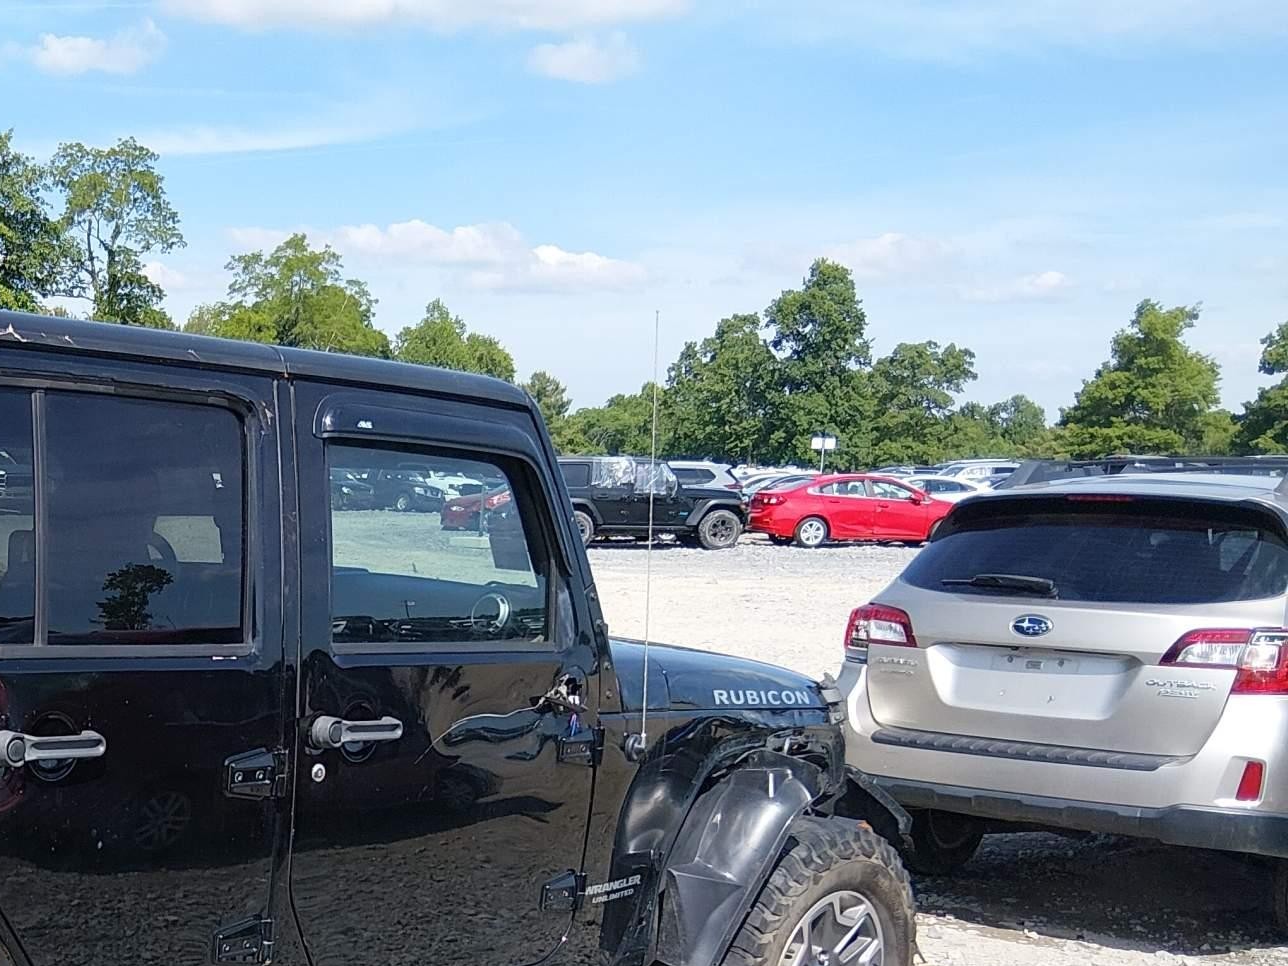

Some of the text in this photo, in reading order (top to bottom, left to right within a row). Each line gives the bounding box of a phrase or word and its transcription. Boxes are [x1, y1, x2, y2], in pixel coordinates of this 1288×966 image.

[713, 689, 810, 705] RUBICON
[585, 874, 641, 896] WRANGLER
[592, 888, 634, 904] UNLIMITED
